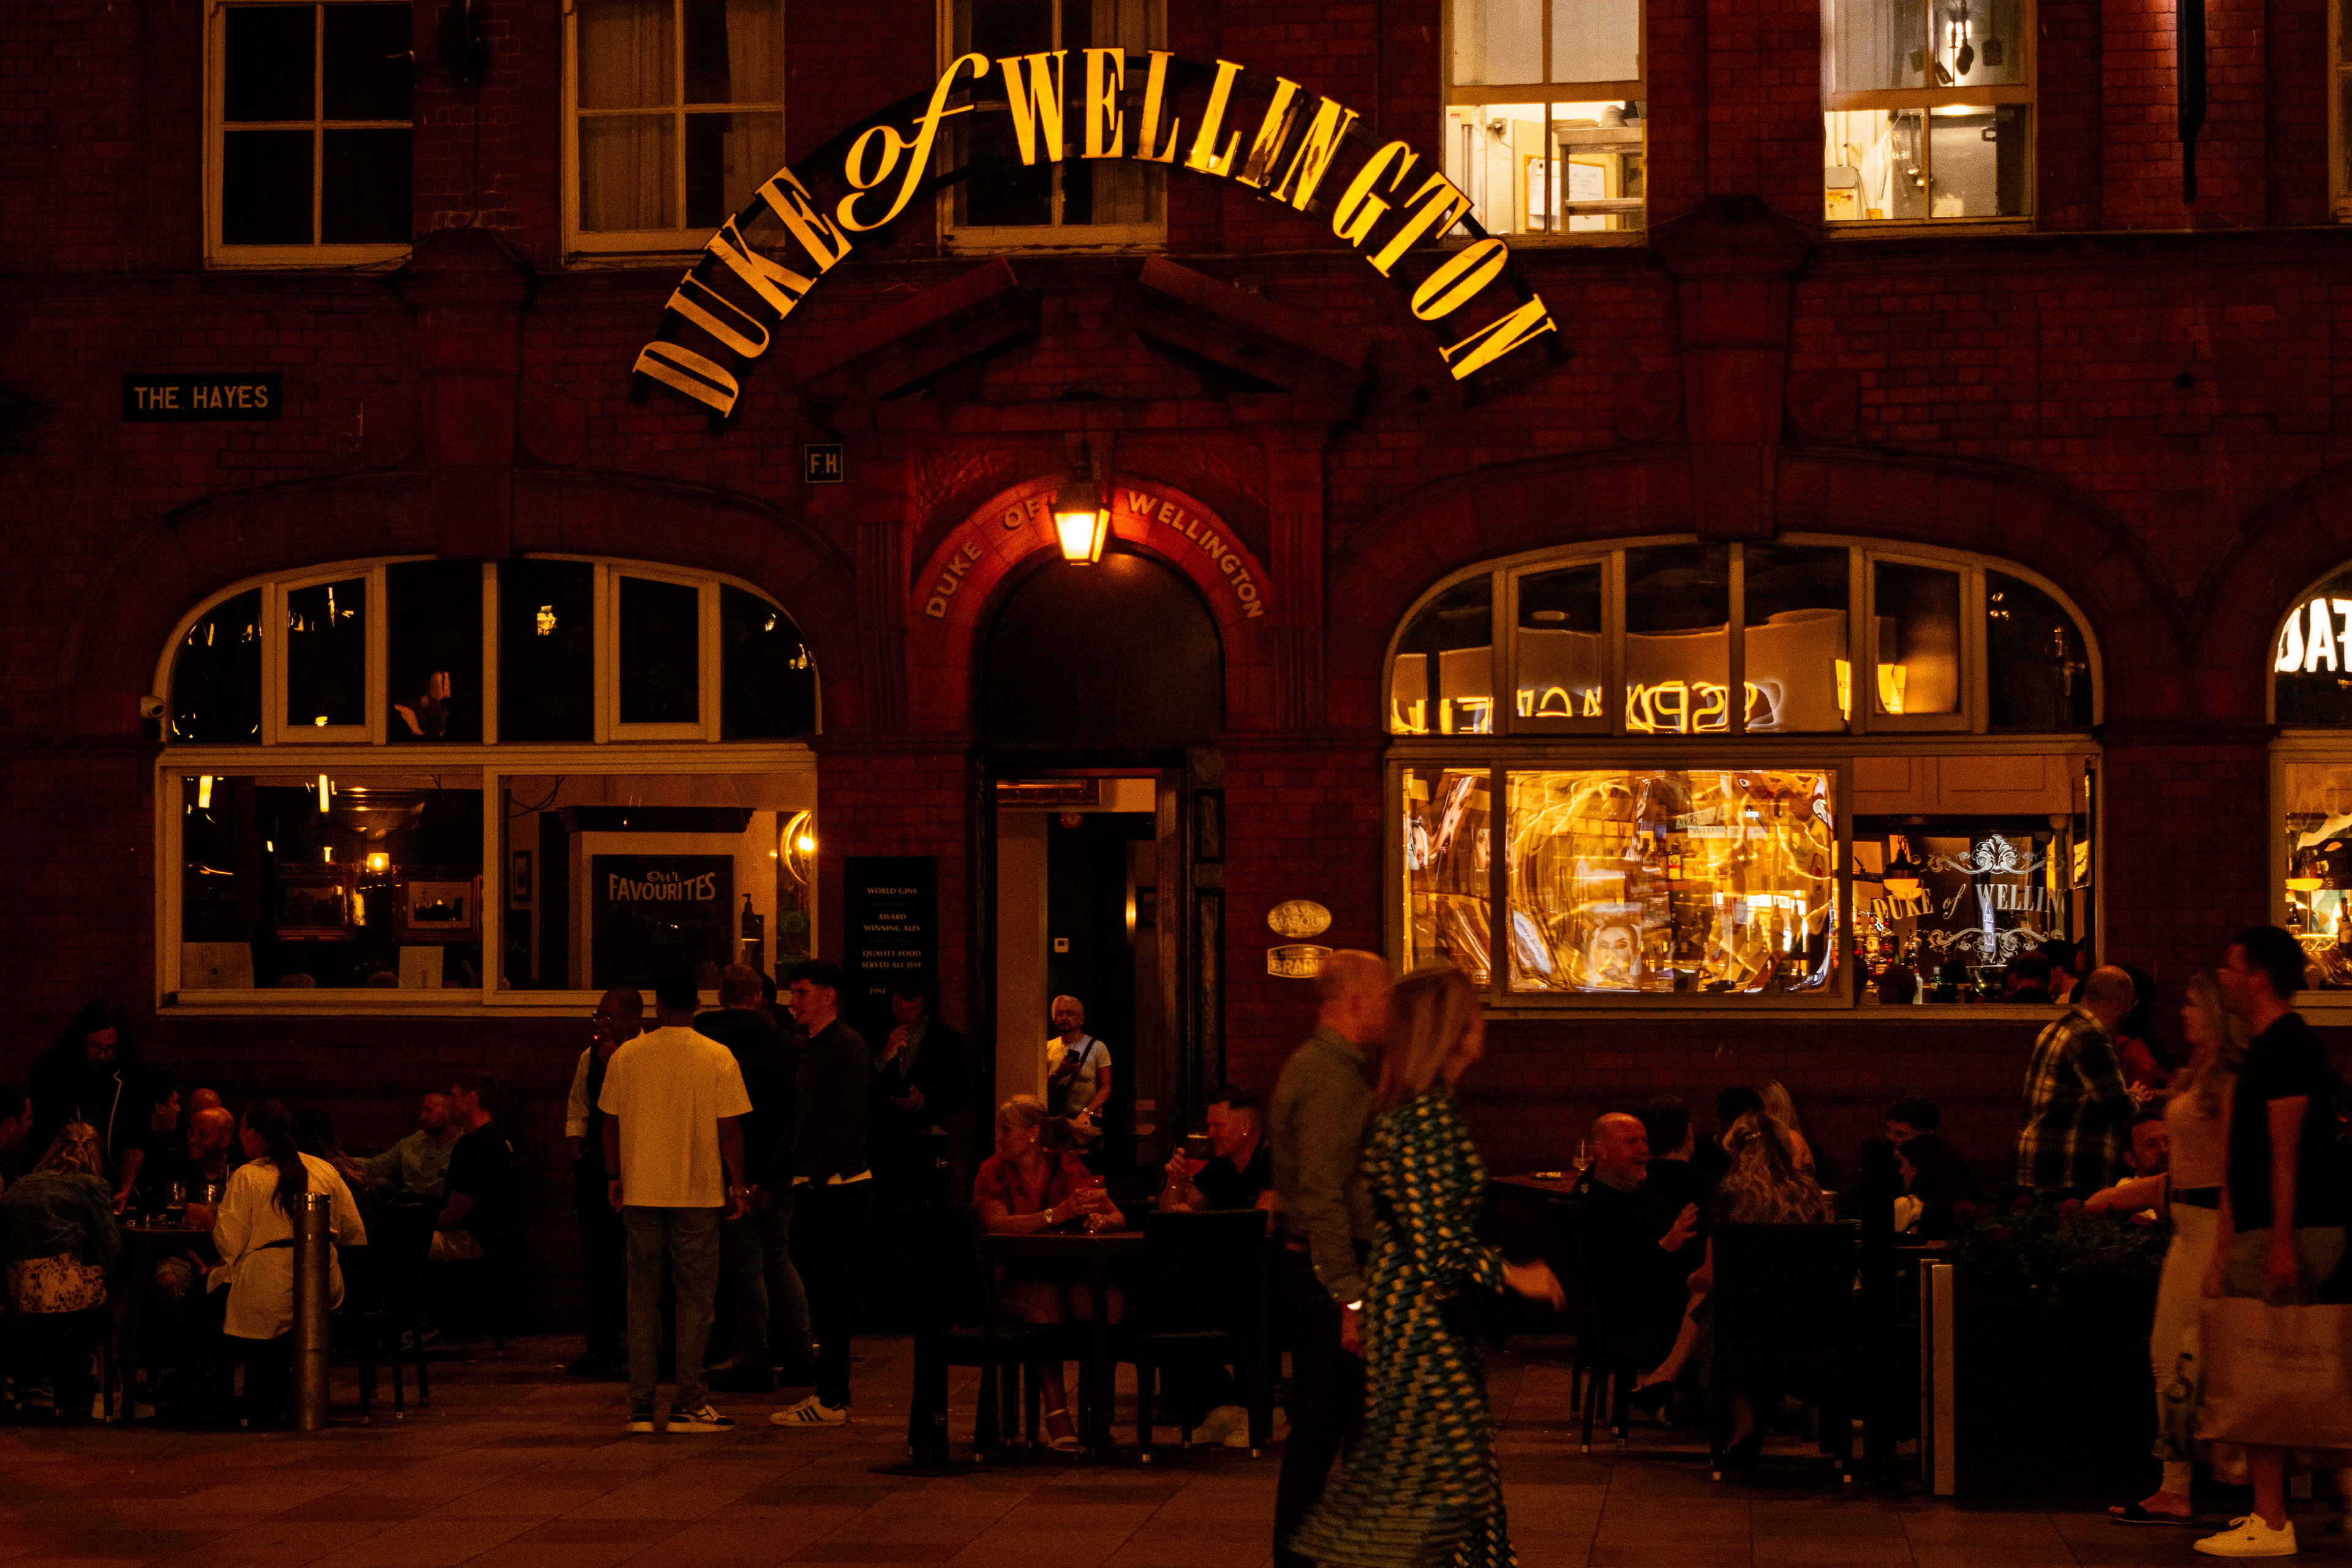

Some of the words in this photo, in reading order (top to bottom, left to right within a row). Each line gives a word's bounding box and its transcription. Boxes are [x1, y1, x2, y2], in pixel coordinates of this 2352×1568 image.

[632, 166, 852, 418] DUKE
[837, 53, 989, 231] of
[997, 48, 1557, 381] WELLINGTON
[134, 386, 179, 409] THE
[194, 385, 268, 409] HAYES
[926, 541, 981, 619] DUKE
[1003, 497, 1041, 529] OF
[1129, 490, 1264, 619] WELLINGTON
[609, 872, 715, 901] FAVOURITES
[647, 870, 682, 882] Our
[1871, 888, 1934, 924] DUKE
[1943, 884, 1966, 919] of
